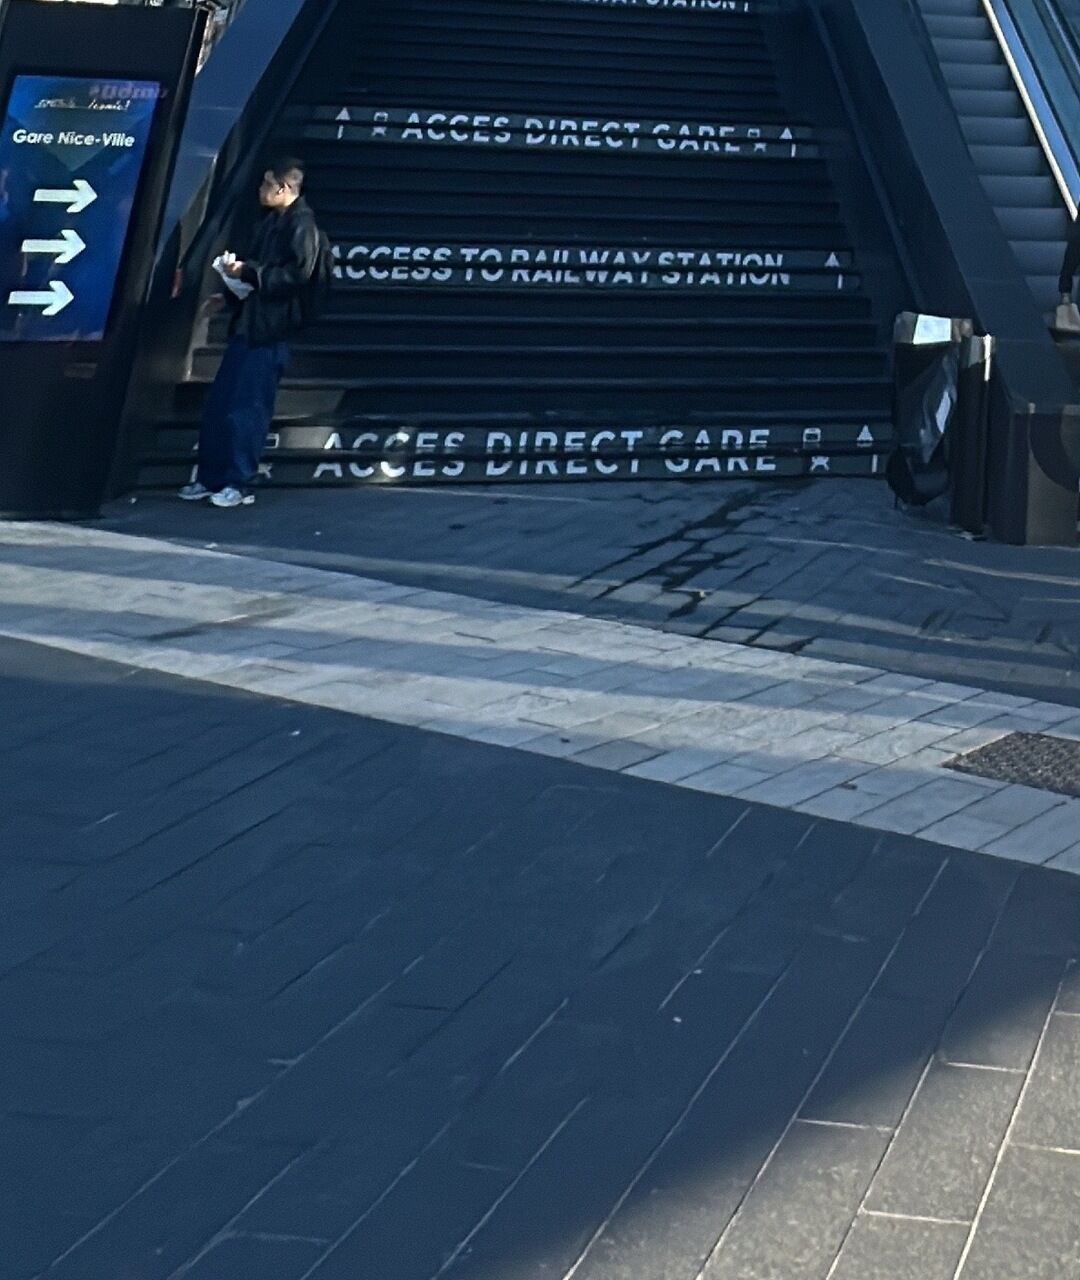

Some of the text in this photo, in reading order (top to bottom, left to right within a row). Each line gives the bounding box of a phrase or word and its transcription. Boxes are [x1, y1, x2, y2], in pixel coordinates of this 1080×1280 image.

[12, 128, 136, 148] Gare Nice-Ville
[401, 112, 741, 153] ACCES DIRECT GARE
[459, 246, 504, 282] TO
[511, 248, 652, 284] RAILWAY
[658, 250, 790, 286] STATION
[313, 427, 777, 478] ACCES DIRECT GARE
